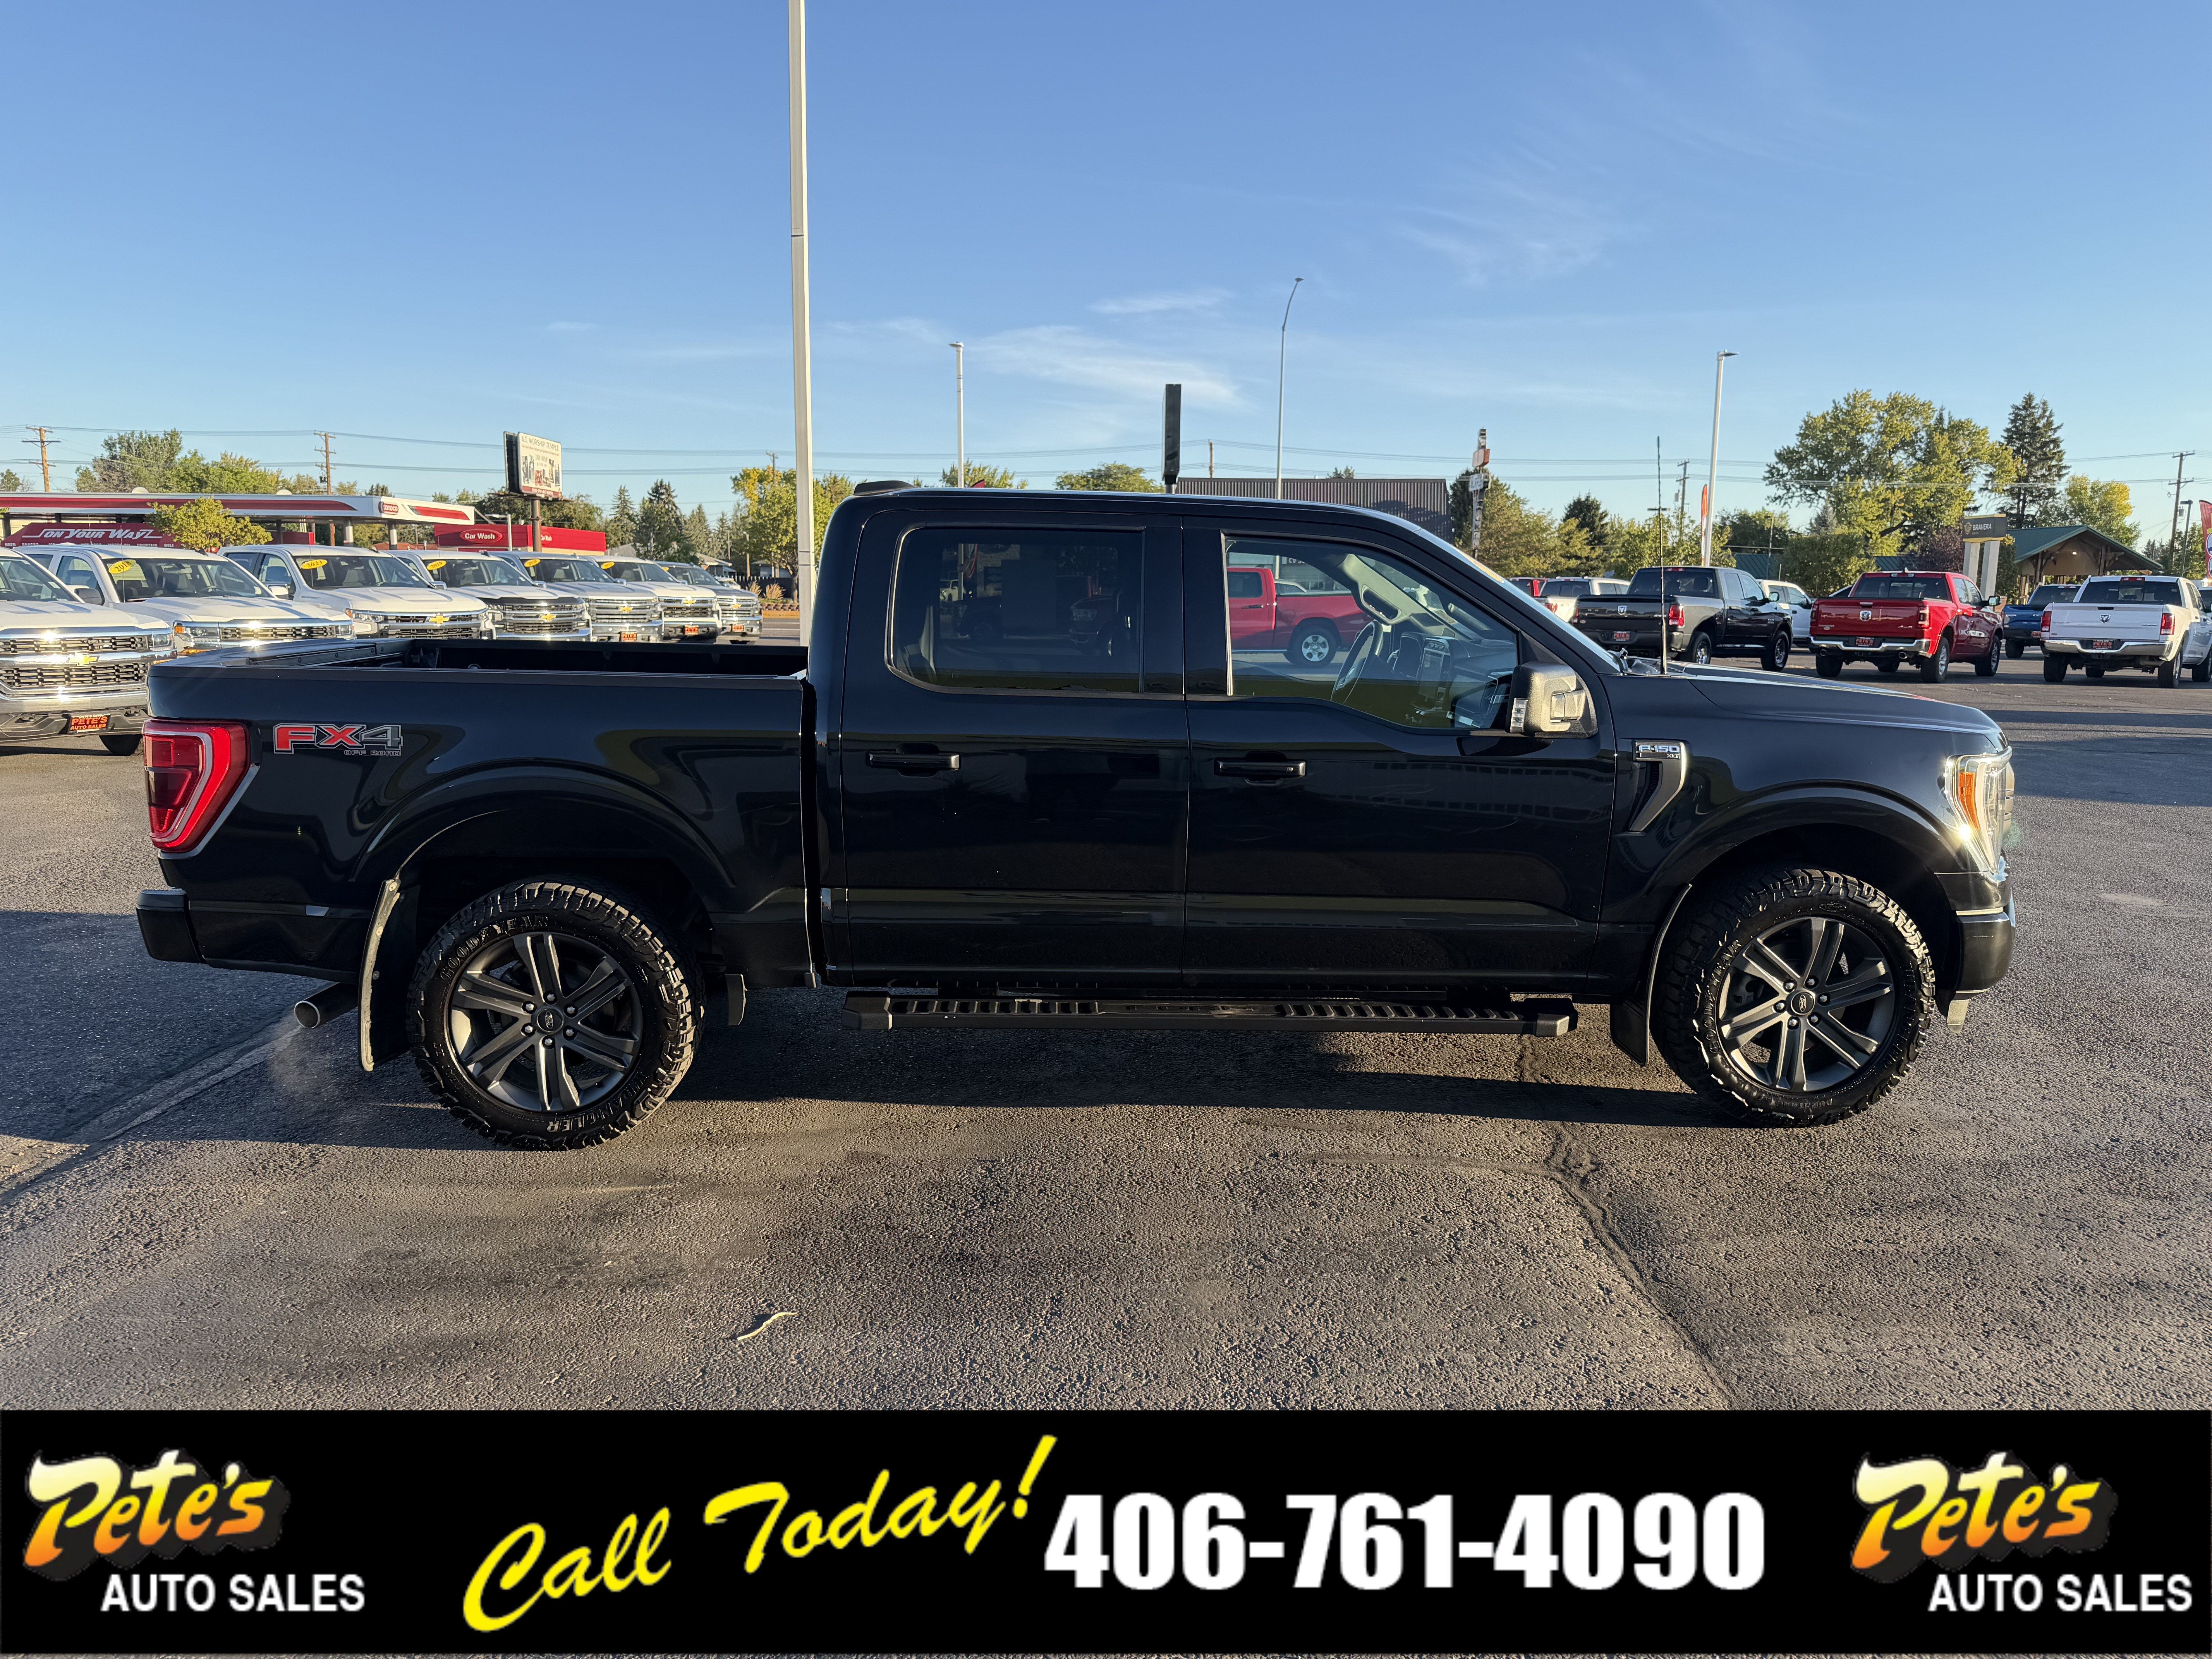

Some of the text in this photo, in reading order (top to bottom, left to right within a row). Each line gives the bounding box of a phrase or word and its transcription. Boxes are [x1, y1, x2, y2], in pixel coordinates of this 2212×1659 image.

[546, 441, 559, 452] TEMPLE
[64, 529, 105, 539] YOUR
[114, 560, 132, 572] 2018
[72, 716, 108, 725] PETE'S
[274, 724, 402, 754] FX4
